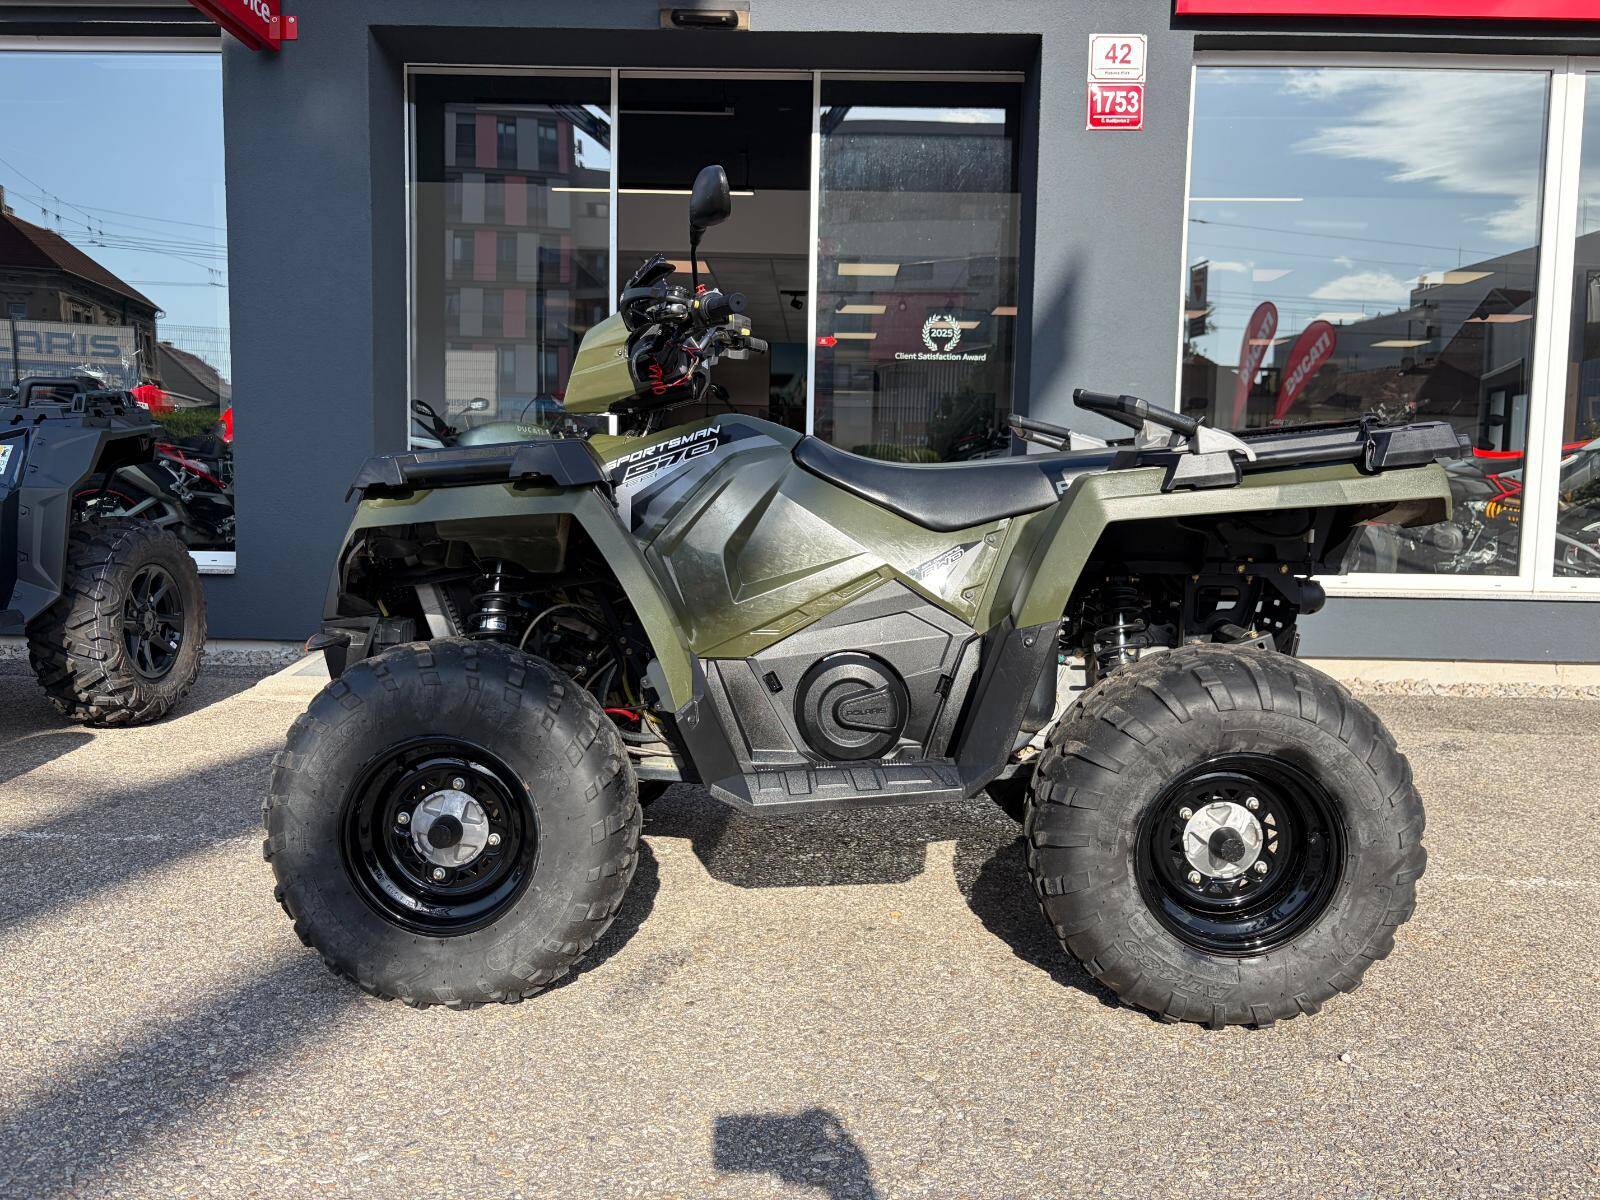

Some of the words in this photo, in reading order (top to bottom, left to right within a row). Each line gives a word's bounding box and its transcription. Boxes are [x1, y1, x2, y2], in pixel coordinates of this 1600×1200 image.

[1104, 43, 1132, 65] 42
[1092, 91, 1139, 113] 1753
[930, 328, 954, 338] 2025
[1240, 311, 1275, 387] DUCATI
[894, 352, 917, 360] Client
[917, 352, 962, 361] Satisfaction
[962, 353, 987, 362] Award
[1284, 331, 1331, 397] DUCATI
[605, 424, 721, 471] SPORTSMAN
[621, 437, 719, 484] 570
